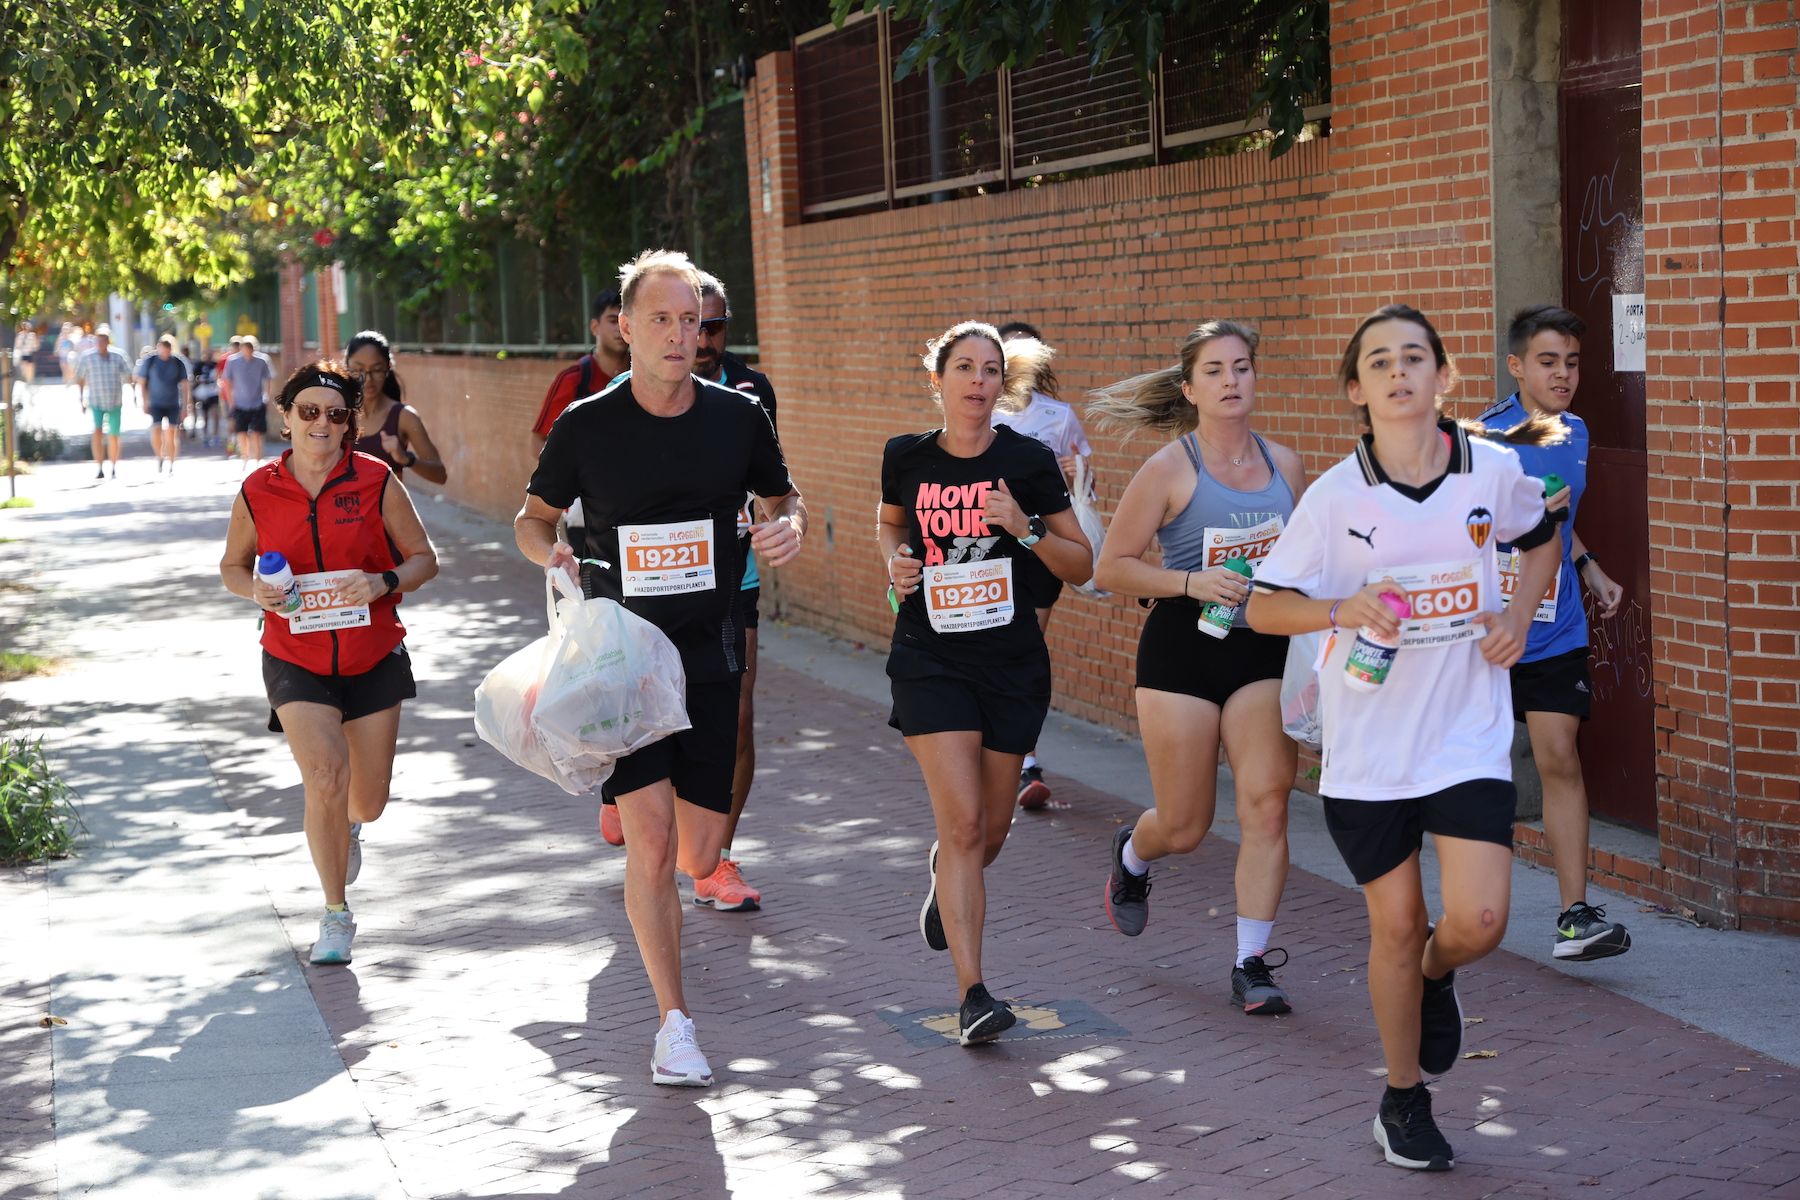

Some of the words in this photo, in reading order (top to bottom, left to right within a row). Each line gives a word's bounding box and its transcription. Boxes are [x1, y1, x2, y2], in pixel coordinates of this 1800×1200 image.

[915, 481, 993, 509] MOVE
[915, 508, 991, 537] YOUR
[635, 544, 699, 569] 19221
[1213, 539, 1276, 565] 20714
[935, 582, 1002, 607] 19220
